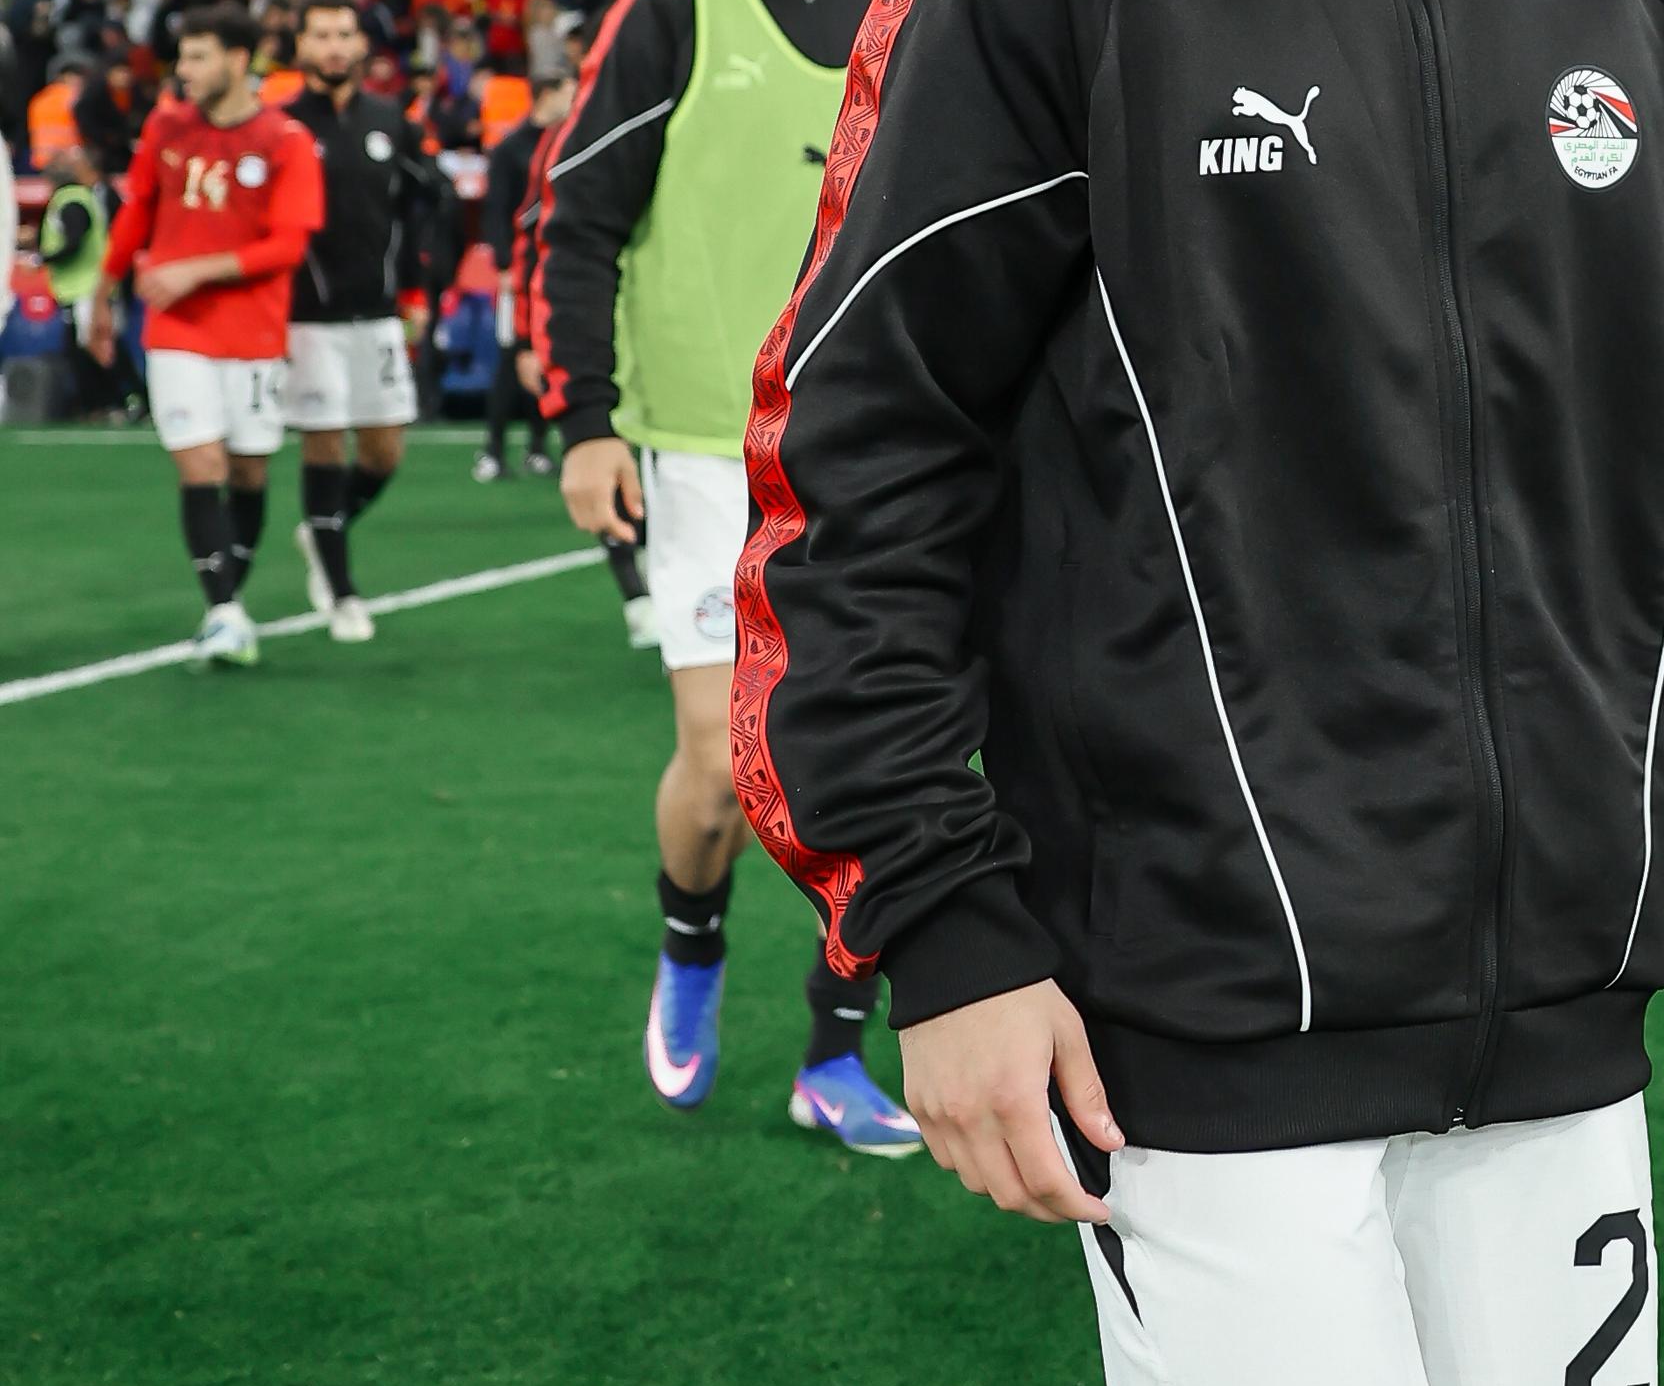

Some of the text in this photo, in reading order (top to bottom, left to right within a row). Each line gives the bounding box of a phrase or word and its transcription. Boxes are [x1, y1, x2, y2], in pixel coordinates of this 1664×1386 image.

[1199, 135, 1284, 176] KING
[1574, 165, 1619, 181] EGYPTIAN FA
[183, 155, 230, 212] 14
